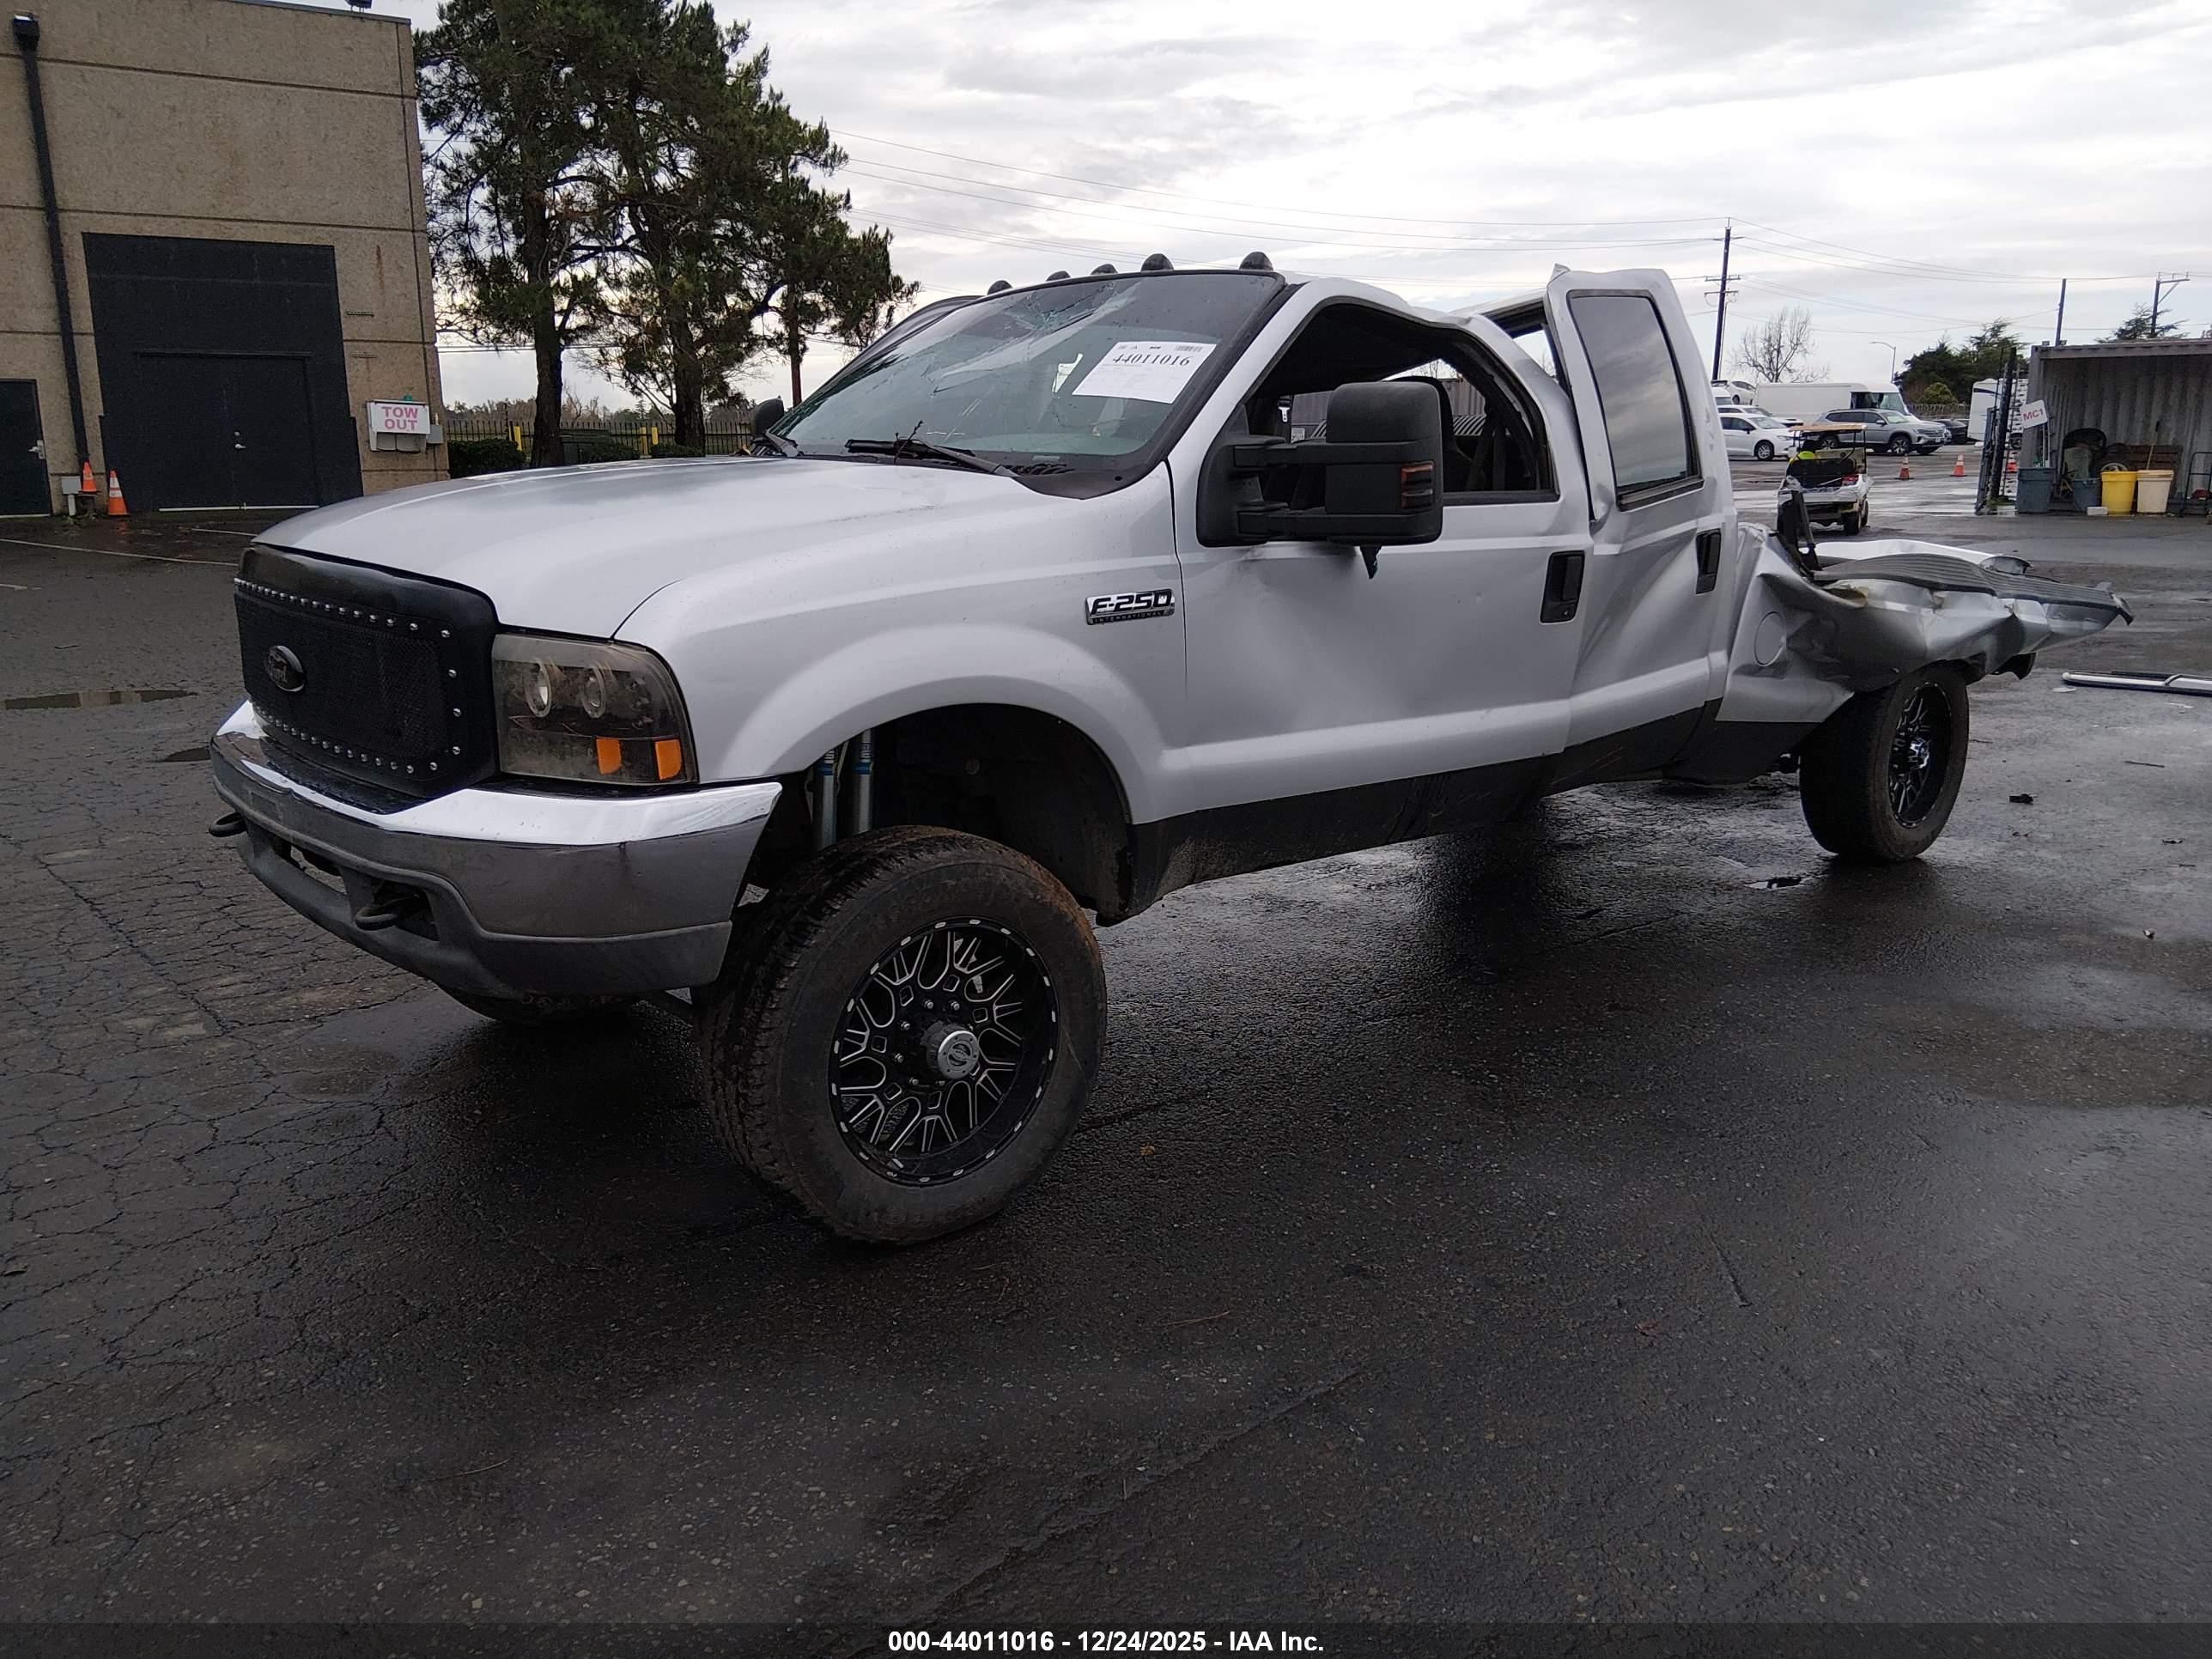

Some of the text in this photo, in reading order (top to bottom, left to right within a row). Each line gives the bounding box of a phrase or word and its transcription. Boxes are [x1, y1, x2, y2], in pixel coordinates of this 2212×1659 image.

[1113, 353, 1194, 367] 44011016
[381, 406, 419, 418] TOW
[2022, 408, 2044, 422] MC1
[384, 418, 418, 431] OUT
[1090, 590, 1173, 616] F-250
